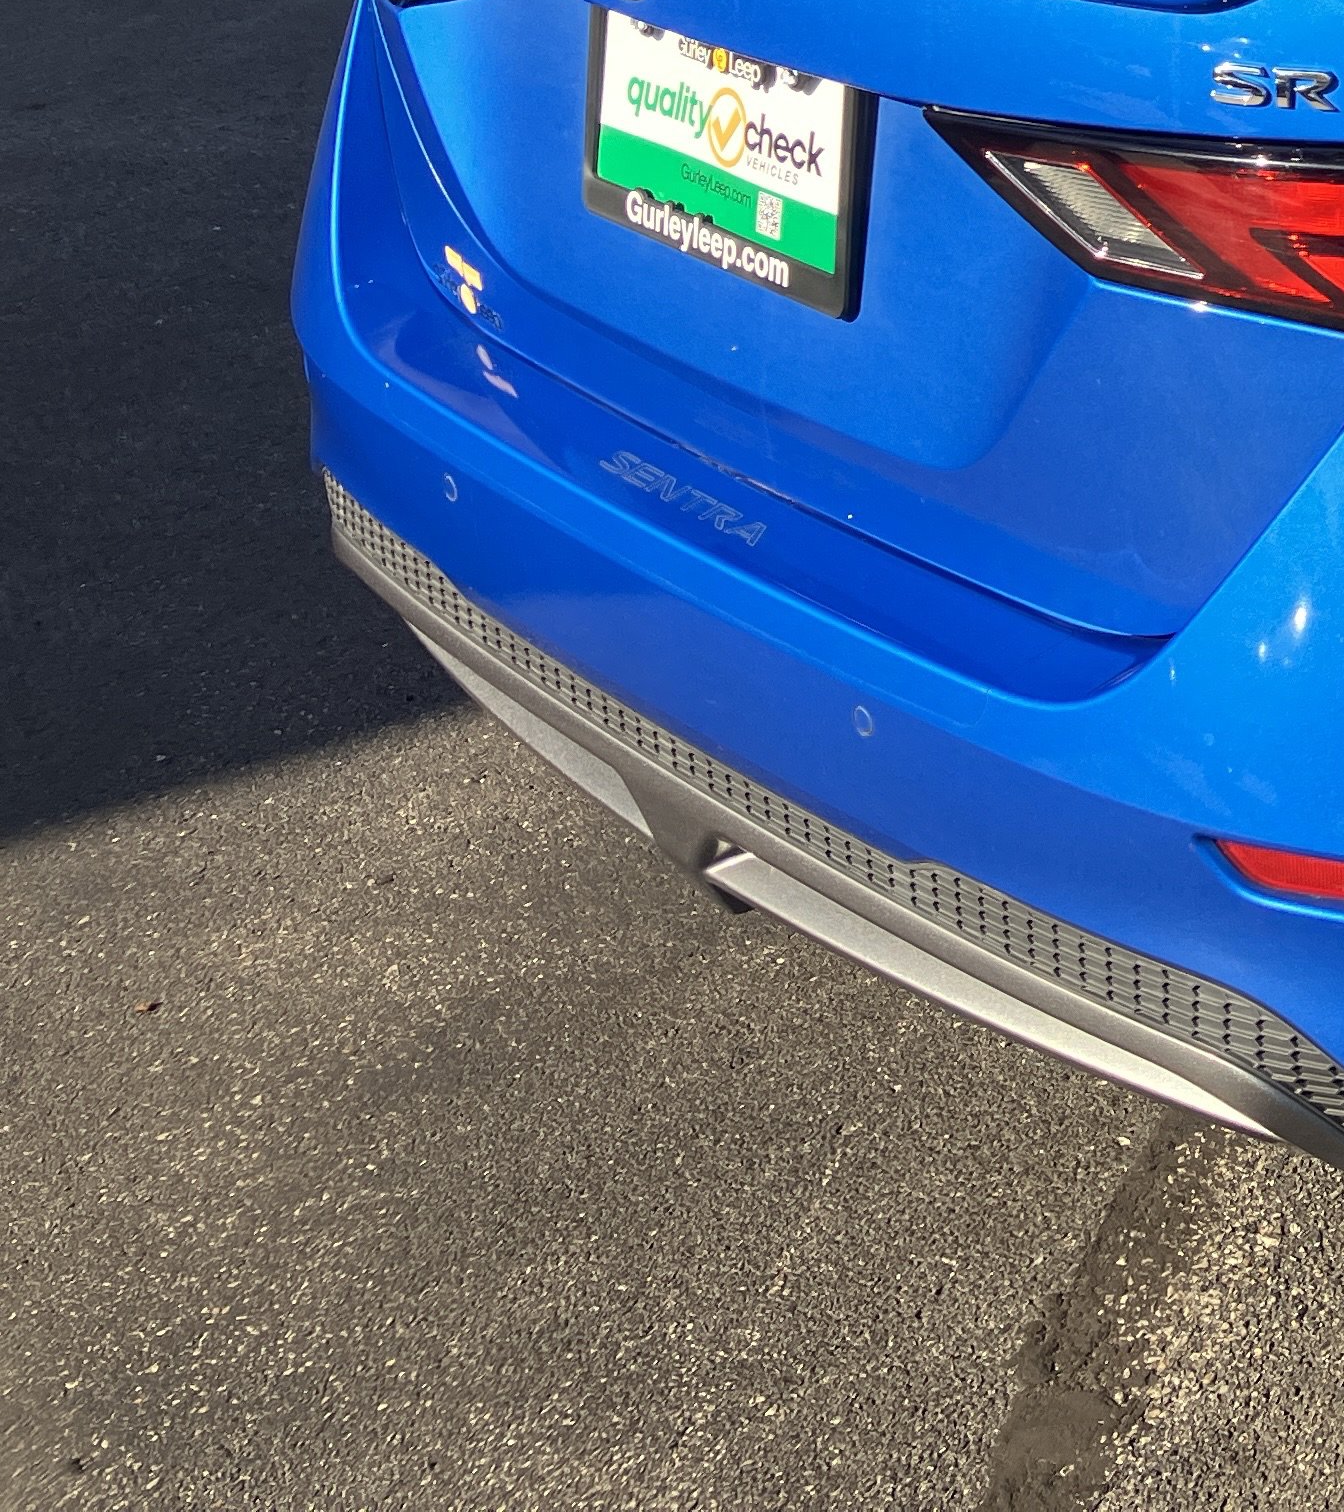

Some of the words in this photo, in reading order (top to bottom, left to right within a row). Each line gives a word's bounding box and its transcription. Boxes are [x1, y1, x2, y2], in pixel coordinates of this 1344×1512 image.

[729, 51, 762, 85] Leep
[1210, 61, 1340, 112] SR
[627, 76, 713, 139] quality
[744, 113, 825, 178] check
[745, 156, 799, 186] VEHICLES
[625, 189, 790, 288] Gurleyleep.com
[600, 450, 767, 547] SENTRA
